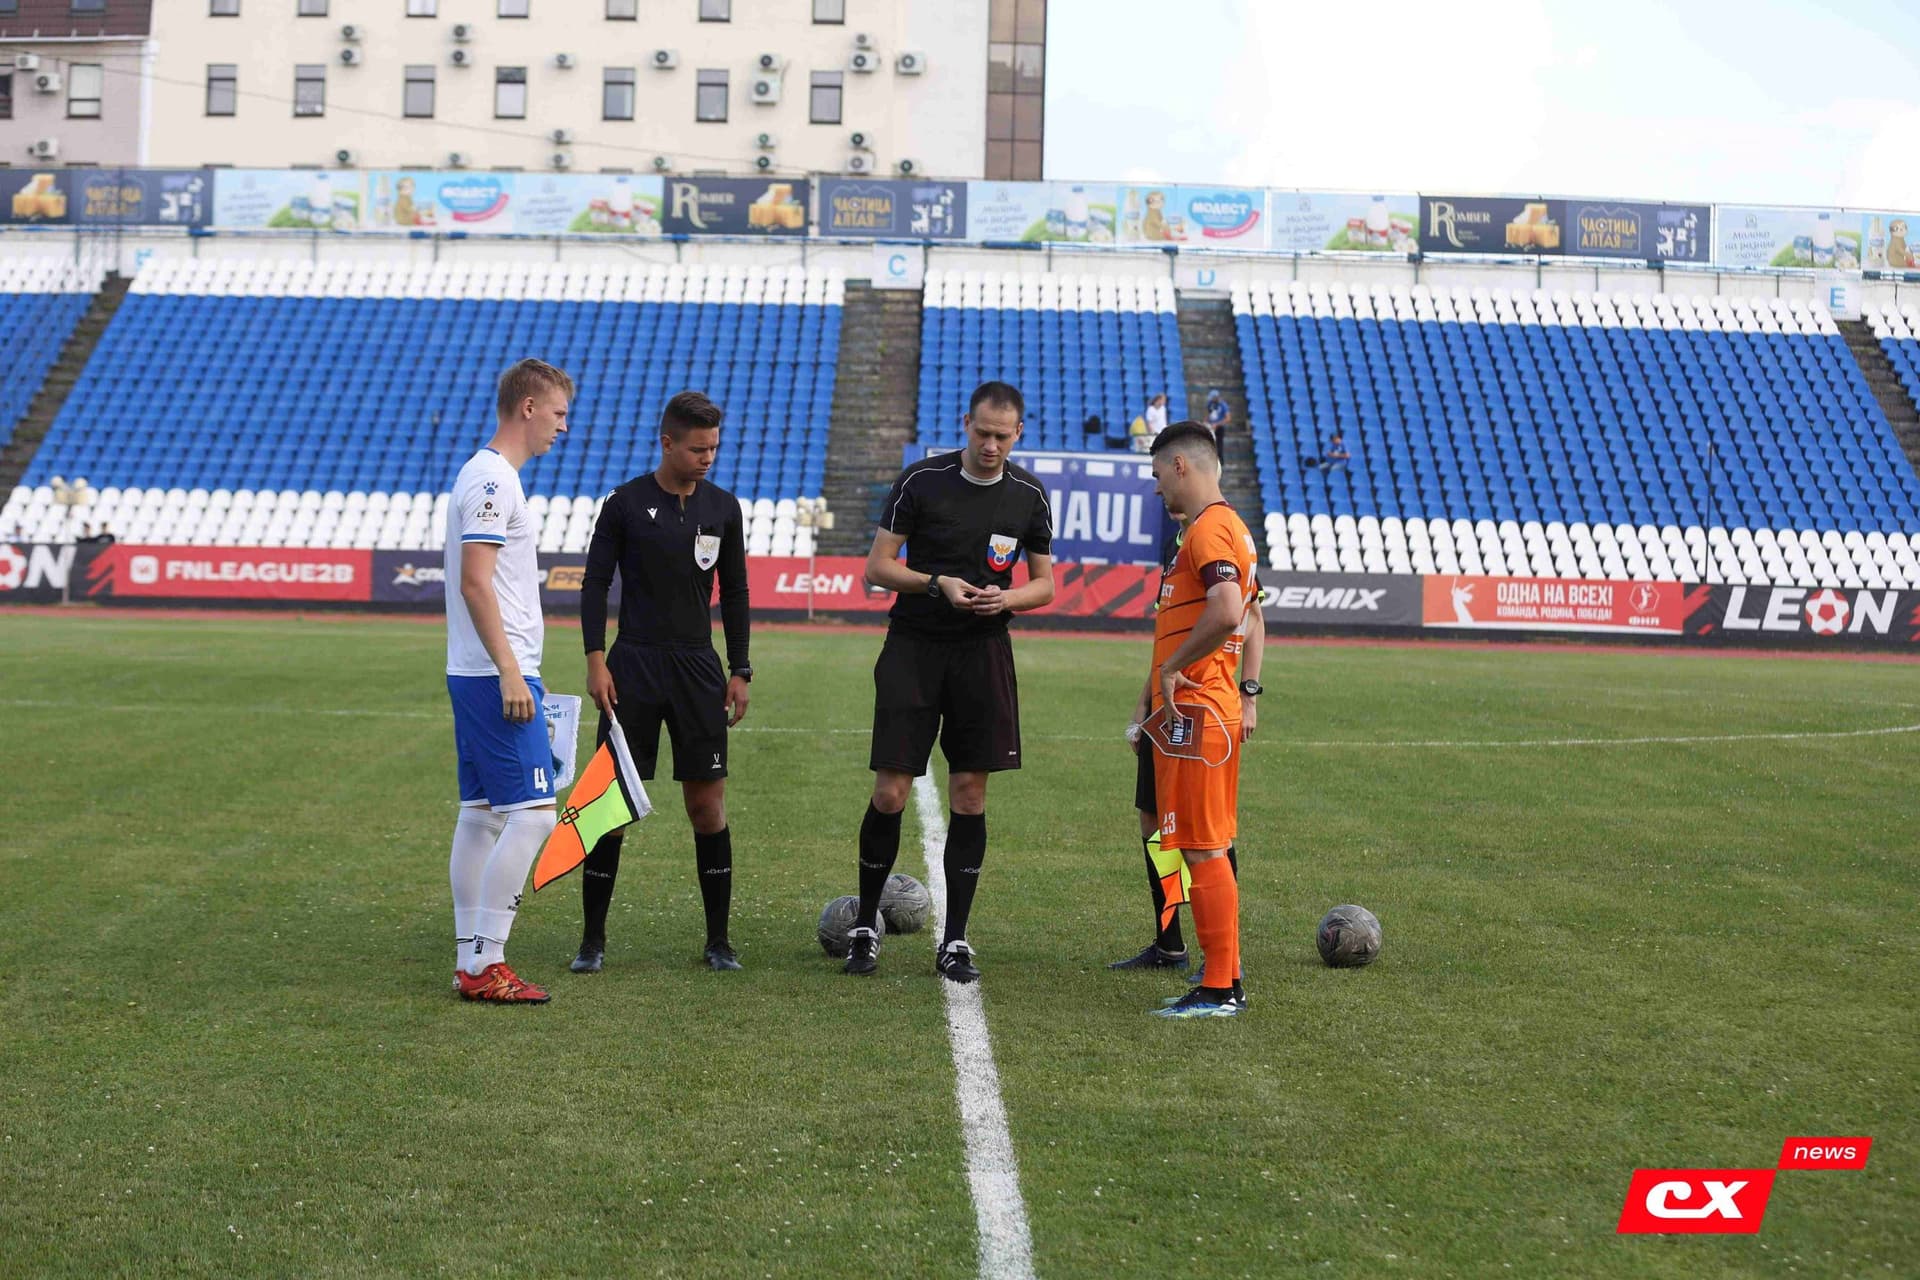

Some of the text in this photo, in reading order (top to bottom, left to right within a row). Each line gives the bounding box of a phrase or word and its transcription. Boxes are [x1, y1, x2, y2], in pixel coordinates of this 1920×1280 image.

[832, 197, 892, 214] ЧАСТИЦА
[1191, 201, 1249, 216] МОДЕСТ
[1580, 216, 1638, 236] ЧАСТИЦА
[1581, 232, 1622, 249] АЛТАЯ
[1829, 286, 1847, 309] E
[165, 560, 355, 584] FNLEAGUE2B
[774, 572, 855, 595] LEON
[1497, 582, 1614, 607] ОДНА НА ВСЕХ!
[1577, 607, 1613, 621] ПОБЕДА!
[1721, 585, 1900, 637] LEON
[533, 767, 549, 793] 4
